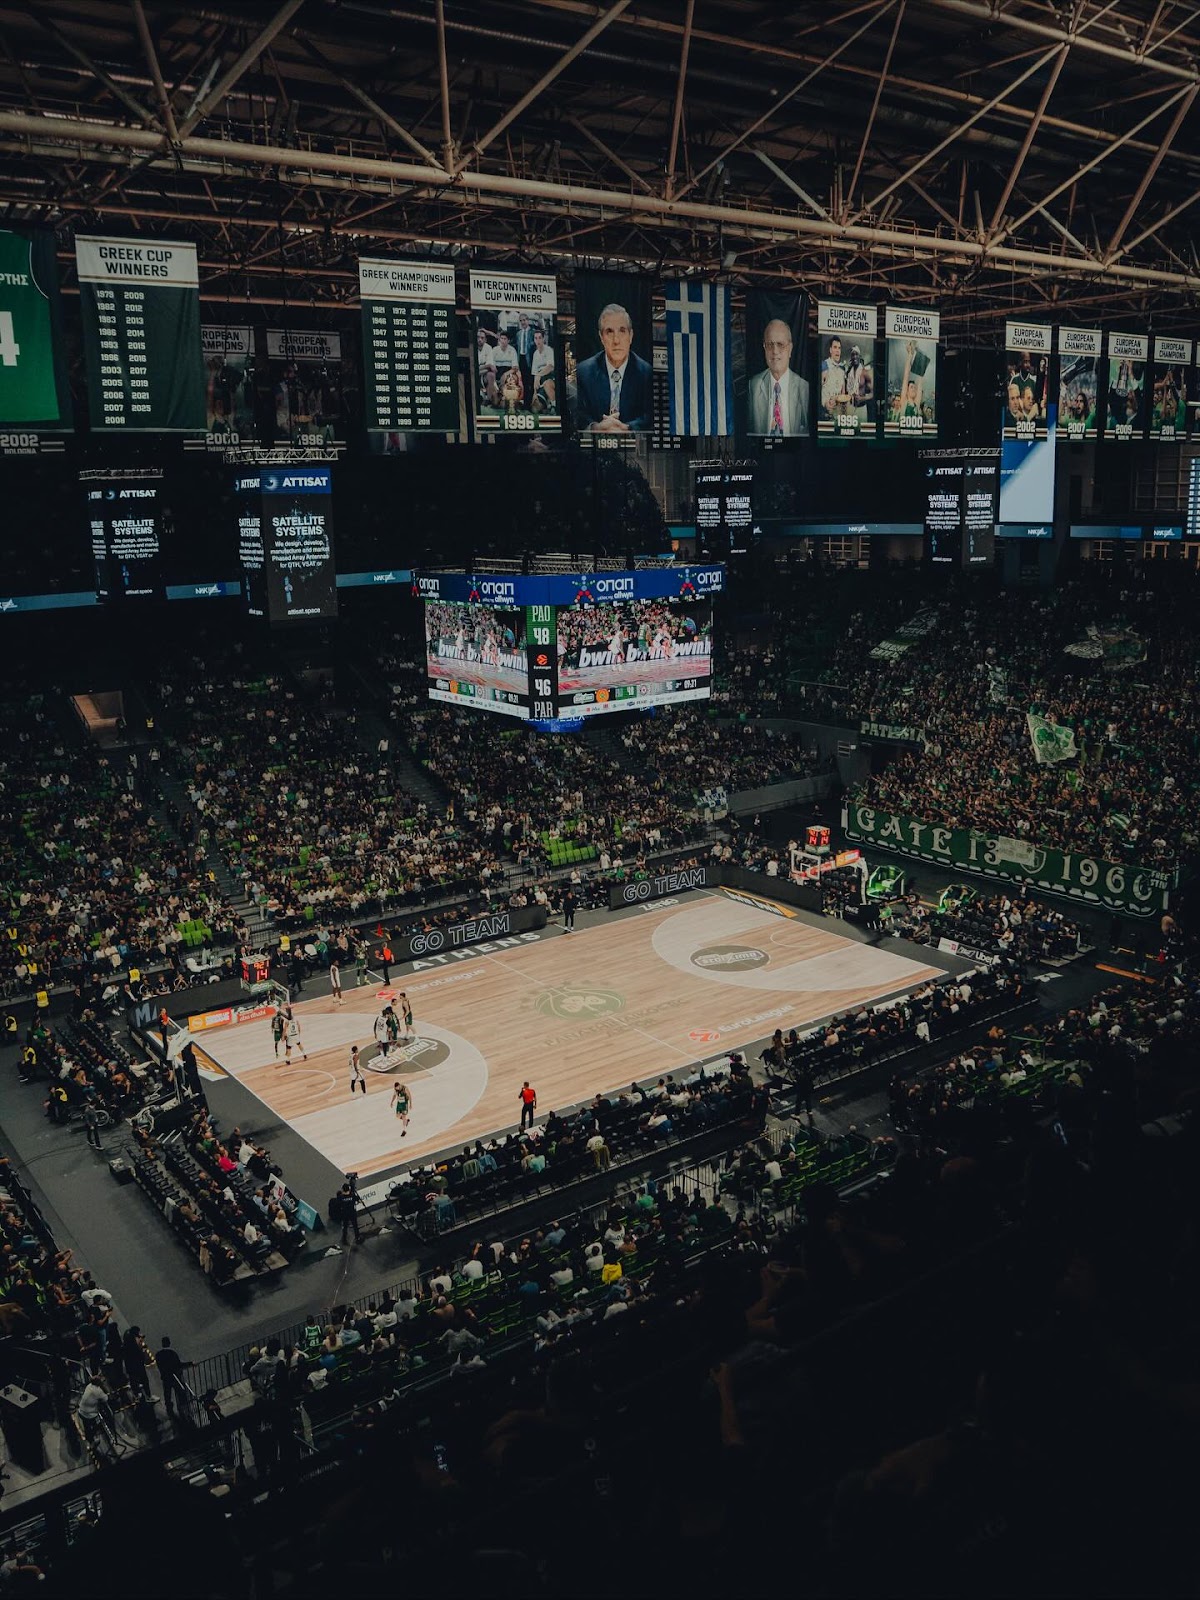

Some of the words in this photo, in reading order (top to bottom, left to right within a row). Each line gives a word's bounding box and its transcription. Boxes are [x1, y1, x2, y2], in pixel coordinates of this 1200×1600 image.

[100, 247, 142, 261] GREEK
[147, 249, 172, 262] CUP
[105, 262, 168, 277] WINNERS
[362, 269, 389, 280] GREEK
[392, 272, 453, 284] CHAMPIONSHIP
[390, 282, 428, 292] WINNERS
[473, 280, 552, 294] INTERCONTINENTAL
[97, 289, 114, 299] 1979
[124, 291, 144, 300] 2009
[485, 291, 501, 301] CUP
[505, 293, 542, 303] WINNERS
[125, 304, 143, 312] 2012
[99, 315, 116, 323] 1983
[830, 309, 867, 320] EUROPEAN
[896, 314, 930, 326] EUROPEAN
[827, 319, 869, 331] CHAMPIONS
[894, 324, 932, 336] CHAMPIONS
[127, 329, 145, 337] 2014
[202, 331, 240, 341] ROPEAN
[1014, 328, 1043, 339] EUROPEAN
[1067, 333, 1094, 343] EUROPEAN
[100, 341, 118, 349] 1993
[128, 342, 145, 350] 2015
[202, 340, 243, 351] AMPIONS
[281, 335, 327, 346] EUROPEAN
[1012, 337, 1044, 348] CHAMPIONS
[1065, 341, 1095, 351] CHAMPIONS
[1116, 338, 1141, 348] EUROPEAN
[279, 345, 331, 355] CHAMPIONS
[1114, 346, 1142, 356] CHAMPIONS
[1161, 343, 1184, 351] EUROPEAN
[1160, 350, 1186, 359] CHAMPIONS
[101, 366, 122, 374] 2003
[130, 367, 147, 375] 2017
[103, 391, 124, 399] 2006
[131, 404, 151, 412] 2025
[503, 415, 535, 430] 1996
[838, 414, 858, 427] 1996
[900, 416, 923, 428] 2000
[1016, 421, 1036, 433] 2002
[0, 434, 39, 447] 2002
[597, 439, 618, 449] 1996
[282, 477, 329, 487] ATTISAT
[119, 489, 156, 498] ATTISAT
[111, 519, 155, 528] SATELLITE
[272, 516, 325, 526] SATELLITE
[114, 527, 153, 535] SYSTEMS
[276, 526, 323, 536] SYSTEMS
[531, 605, 551, 622] PAO
[533, 628, 550, 645] 48
[535, 679, 551, 696] 46
[534, 701, 553, 718] PAR
[857, 807, 953, 855] GATE
[622, 880, 651, 903] GO
[654, 867, 707, 895] TEAM
[410, 930, 444, 955] GO
[448, 913, 510, 945] TEAM
[412, 932, 541, 971] ATHENS
[256, 968, 268, 981] 14
[718, 1005, 796, 1032] EuroLeague
